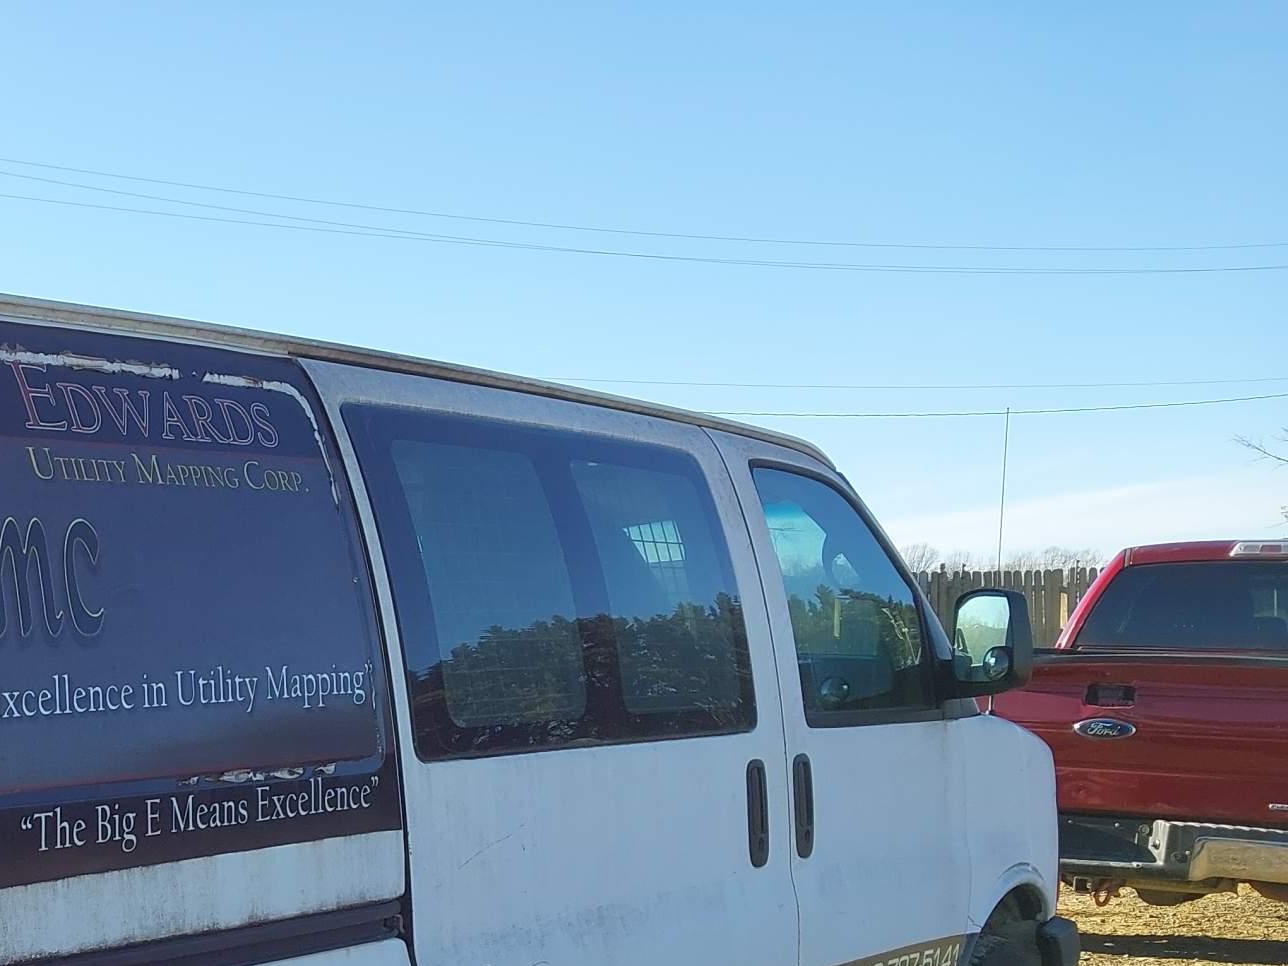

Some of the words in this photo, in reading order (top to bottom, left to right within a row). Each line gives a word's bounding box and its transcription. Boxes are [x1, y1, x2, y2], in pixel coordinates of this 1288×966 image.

[11, 361, 279, 448] EDWARDS
[25, 446, 127, 483] UTILITY
[130, 452, 240, 490] MAPPING
[244, 460, 310, 493] CORP.
[143, 673, 168, 709] in
[175, 665, 259, 713] Utility
[265, 662, 373, 709] Mapping”
[1087, 721, 1121, 736] Ford
[20, 810, 87, 853] “The
[95, 804, 137, 854] Big
[144, 799, 162, 837] E
[170, 793, 249, 834] Means
[256, 776, 380, 823] Excellence”
